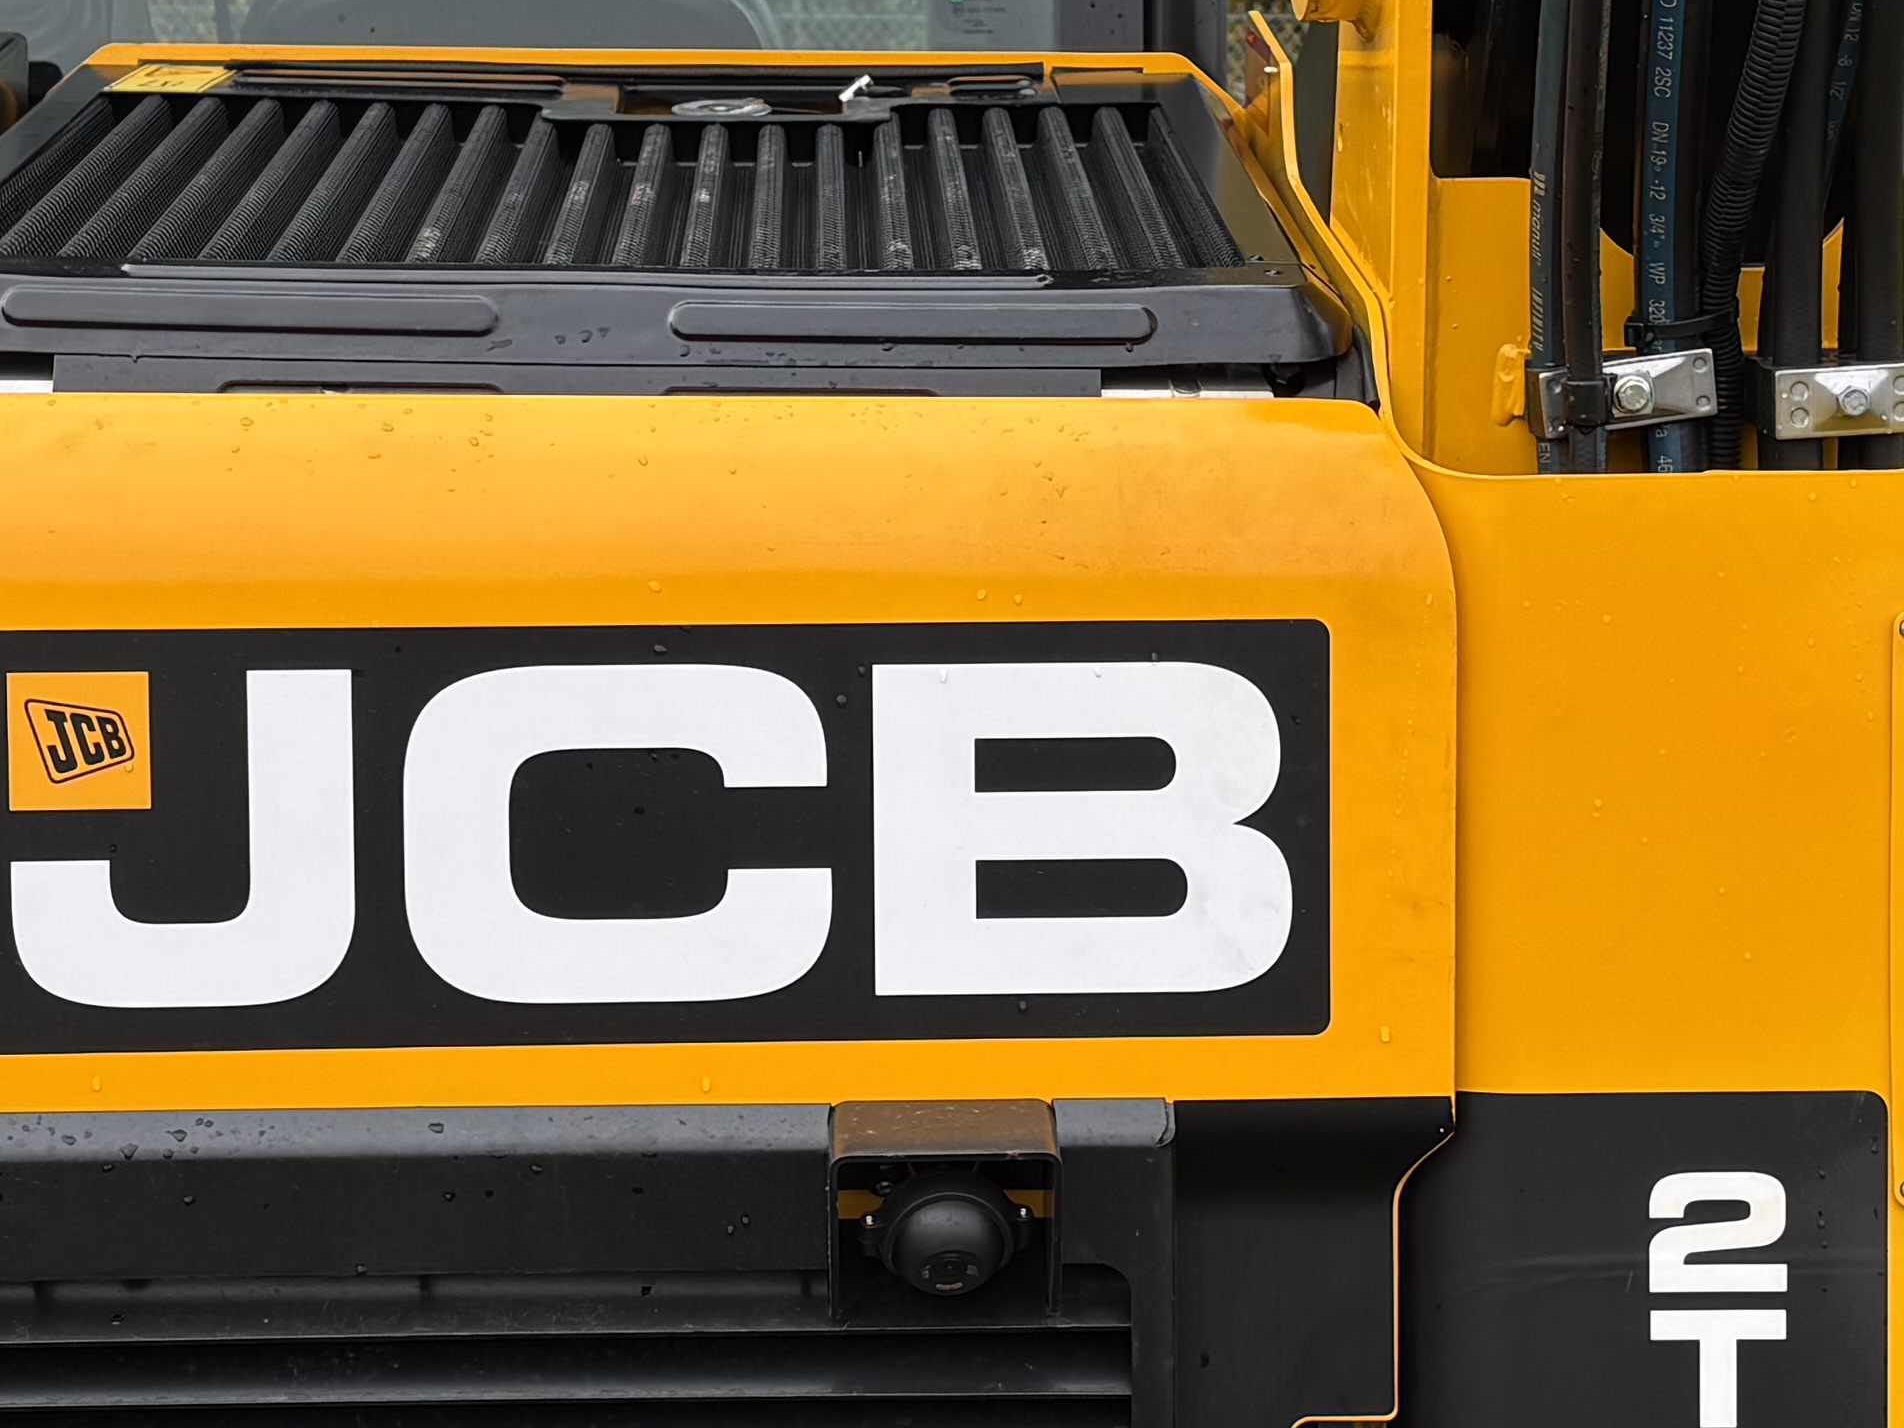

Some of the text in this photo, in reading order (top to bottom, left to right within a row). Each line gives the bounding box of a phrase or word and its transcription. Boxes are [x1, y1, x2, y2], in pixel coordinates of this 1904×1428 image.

[1656, 17, 1675, 60] 11237
[1653, 67, 1672, 98] 2SC
[1651, 121, 1669, 143] DN
[1648, 262, 1664, 285] WP
[1538, 442, 1551, 463] EN
[45, 709, 127, 774] JCB
[10, 663, 1294, 1009] JCB
